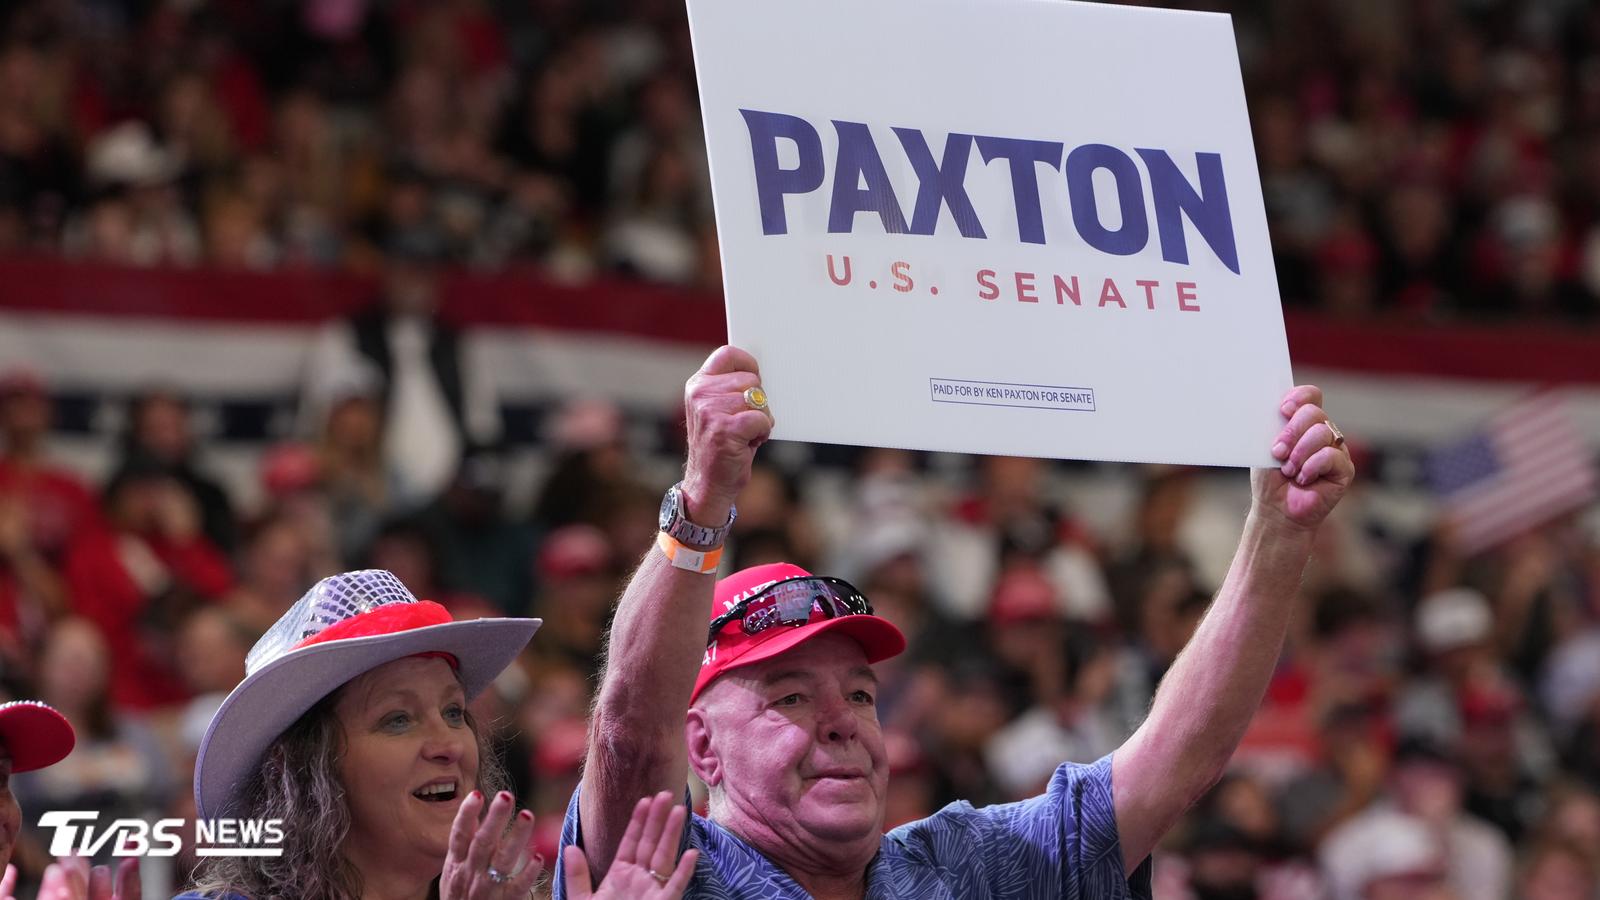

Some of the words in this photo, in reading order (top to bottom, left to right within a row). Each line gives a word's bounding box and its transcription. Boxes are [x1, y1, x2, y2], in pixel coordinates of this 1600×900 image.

[738, 109, 1241, 275] PAXTON
[826, 254, 940, 296] U.S.
[976, 269, 1201, 313] SENATE
[933, 383, 953, 396] PAID
[955, 385, 972, 397] FOR
[974, 387, 984, 397] BY
[986, 388, 1003, 399] KEN
[1005, 389, 1040, 401] PAXTON
[1041, 391, 1059, 402] FOR
[1060, 392, 1092, 403] SENATE
[722, 580, 777, 611] MA
